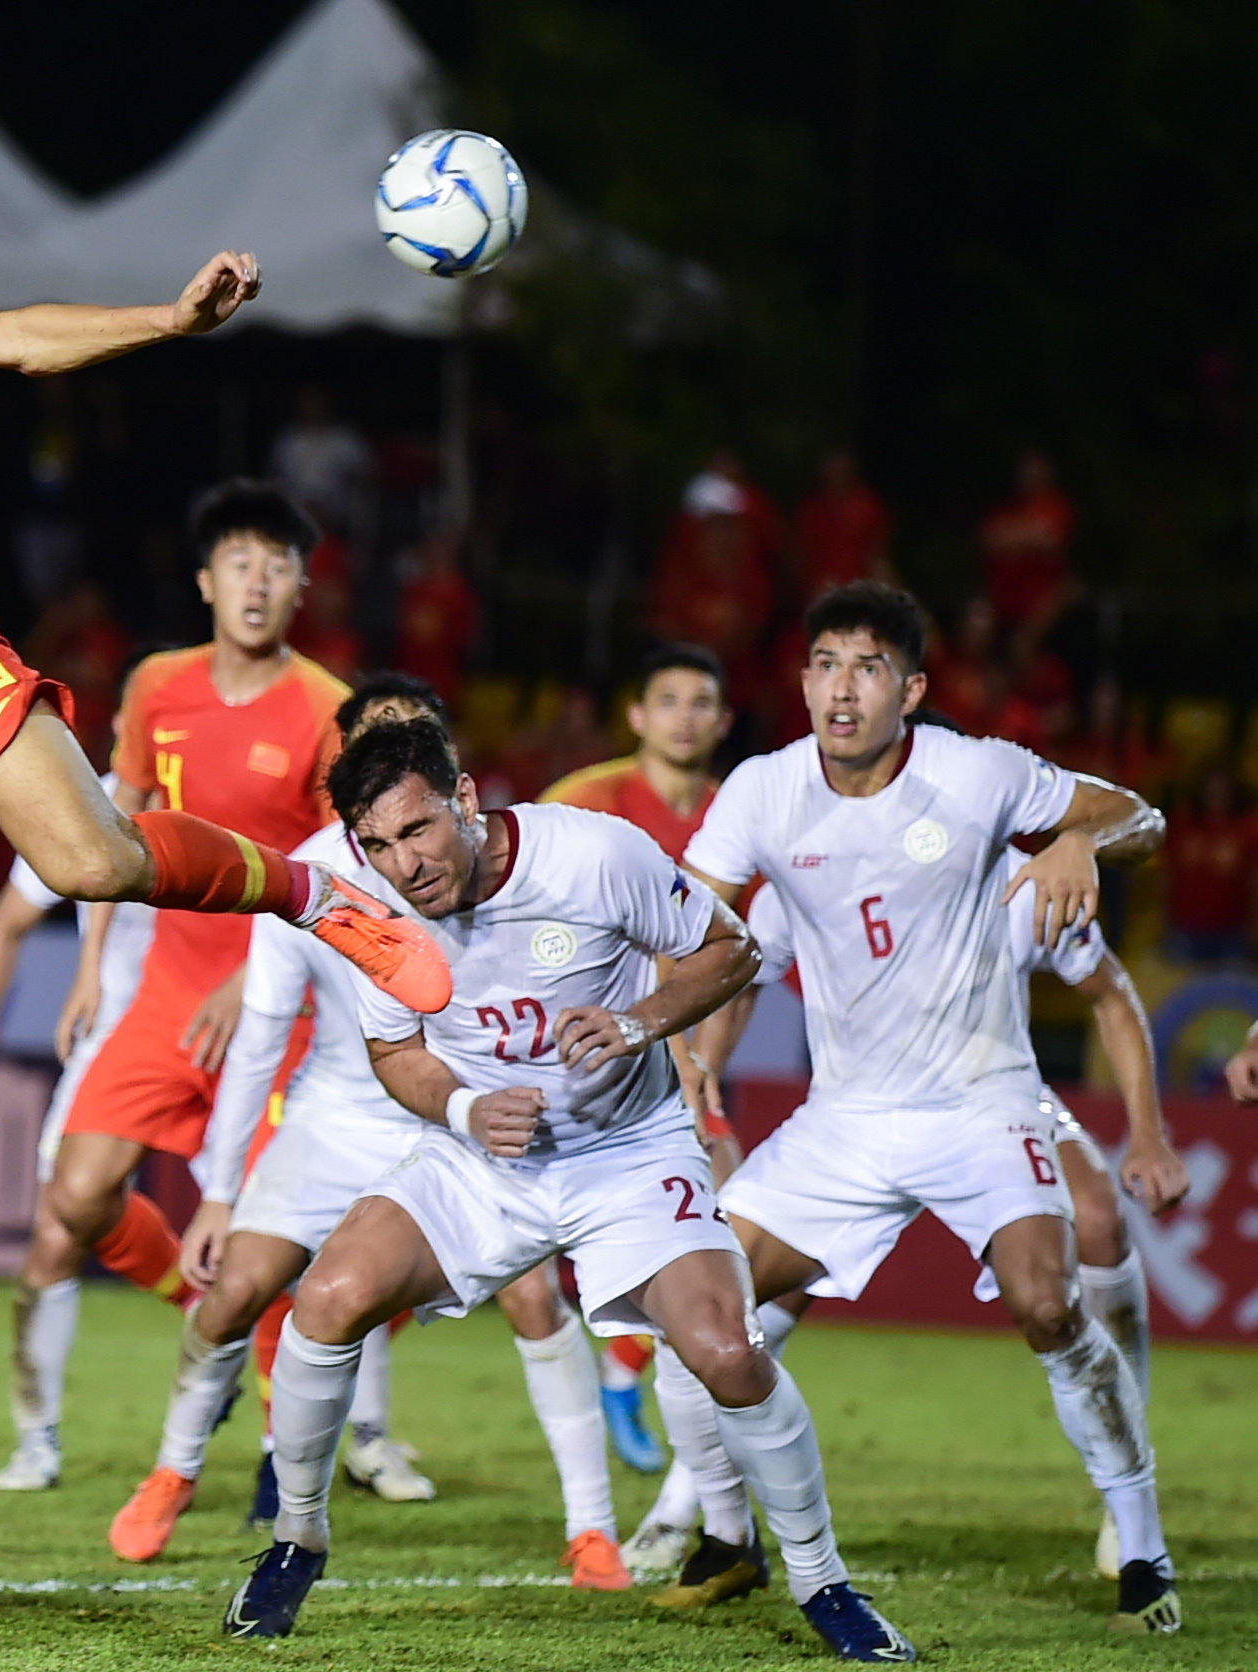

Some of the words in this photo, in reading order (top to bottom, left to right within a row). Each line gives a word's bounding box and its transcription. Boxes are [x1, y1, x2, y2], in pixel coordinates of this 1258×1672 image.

[156, 750, 183, 811] 4
[859, 894, 893, 960] 6
[476, 997, 556, 1061] 22
[1023, 1137, 1057, 1186] 6
